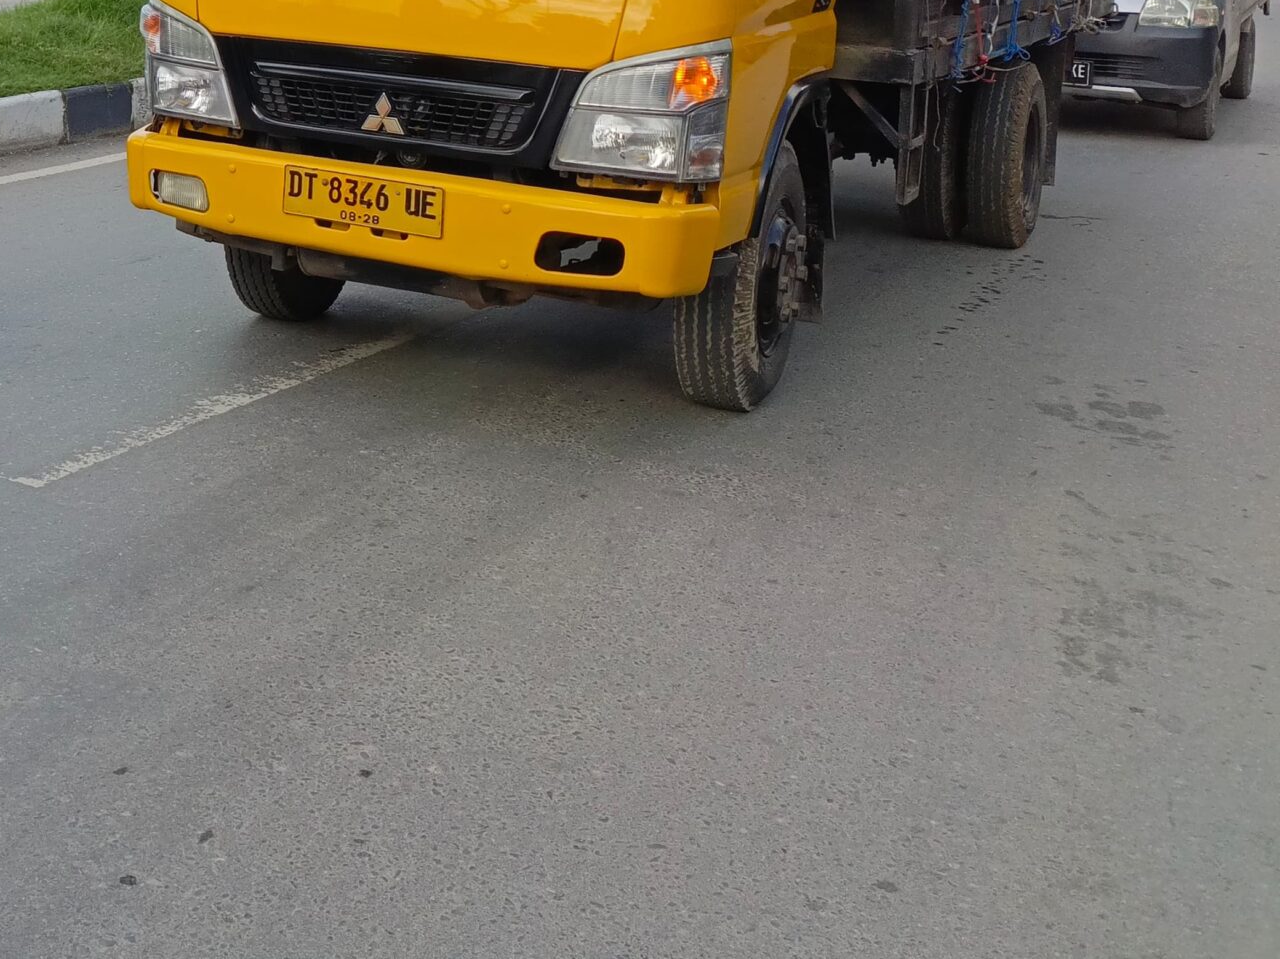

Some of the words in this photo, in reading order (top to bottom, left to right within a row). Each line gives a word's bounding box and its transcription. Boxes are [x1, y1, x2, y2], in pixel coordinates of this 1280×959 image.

[288, 170, 318, 200] DT
[328, 176, 389, 212] 8346
[405, 187, 437, 220] UE
